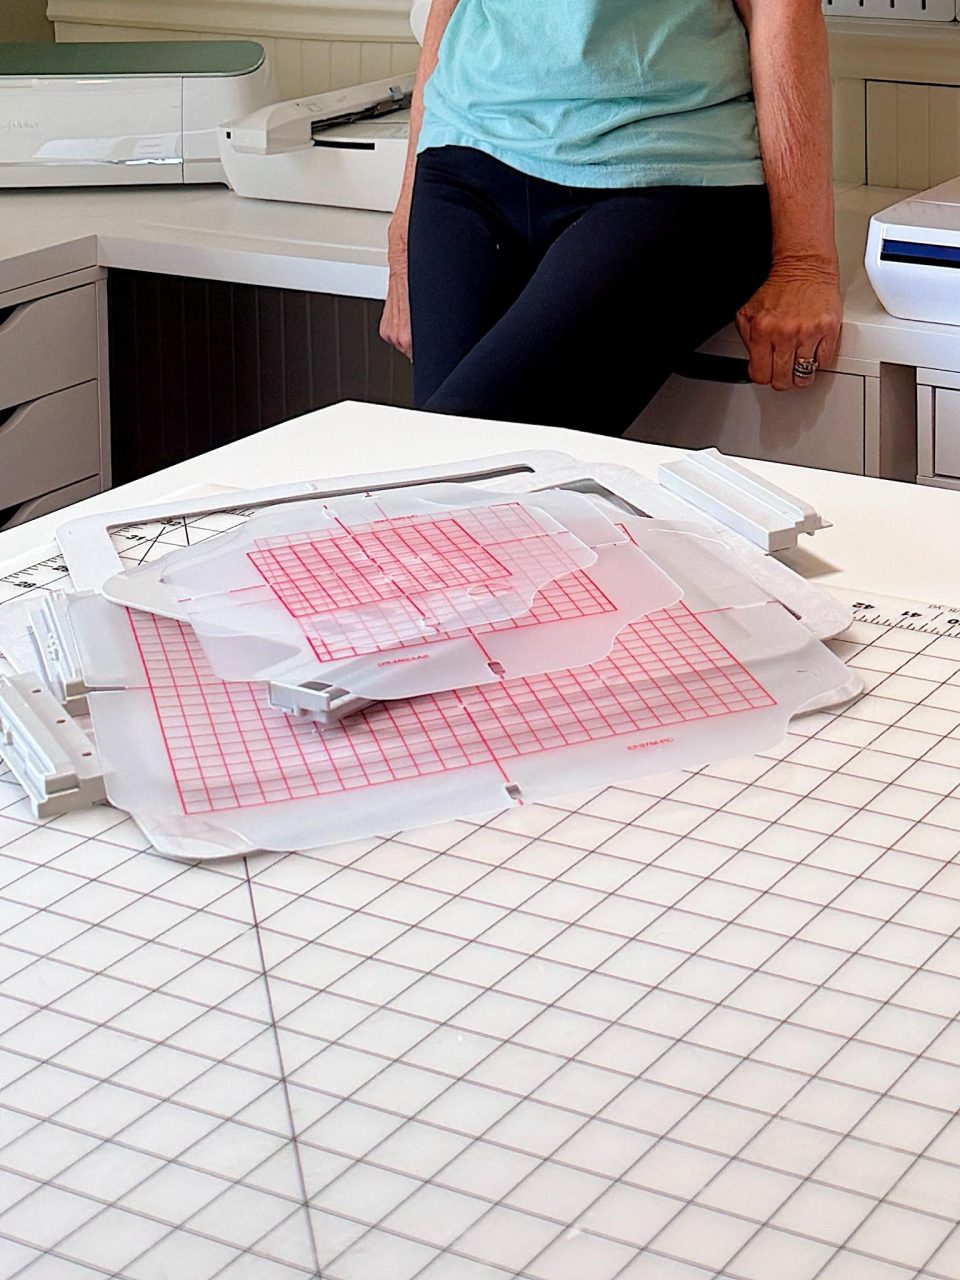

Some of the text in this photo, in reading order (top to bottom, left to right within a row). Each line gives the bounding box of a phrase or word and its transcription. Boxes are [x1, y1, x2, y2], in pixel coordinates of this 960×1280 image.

[13, 581, 37, 589] 28
[851, 601, 875, 610] 42
[901, 610, 922, 618] 41
